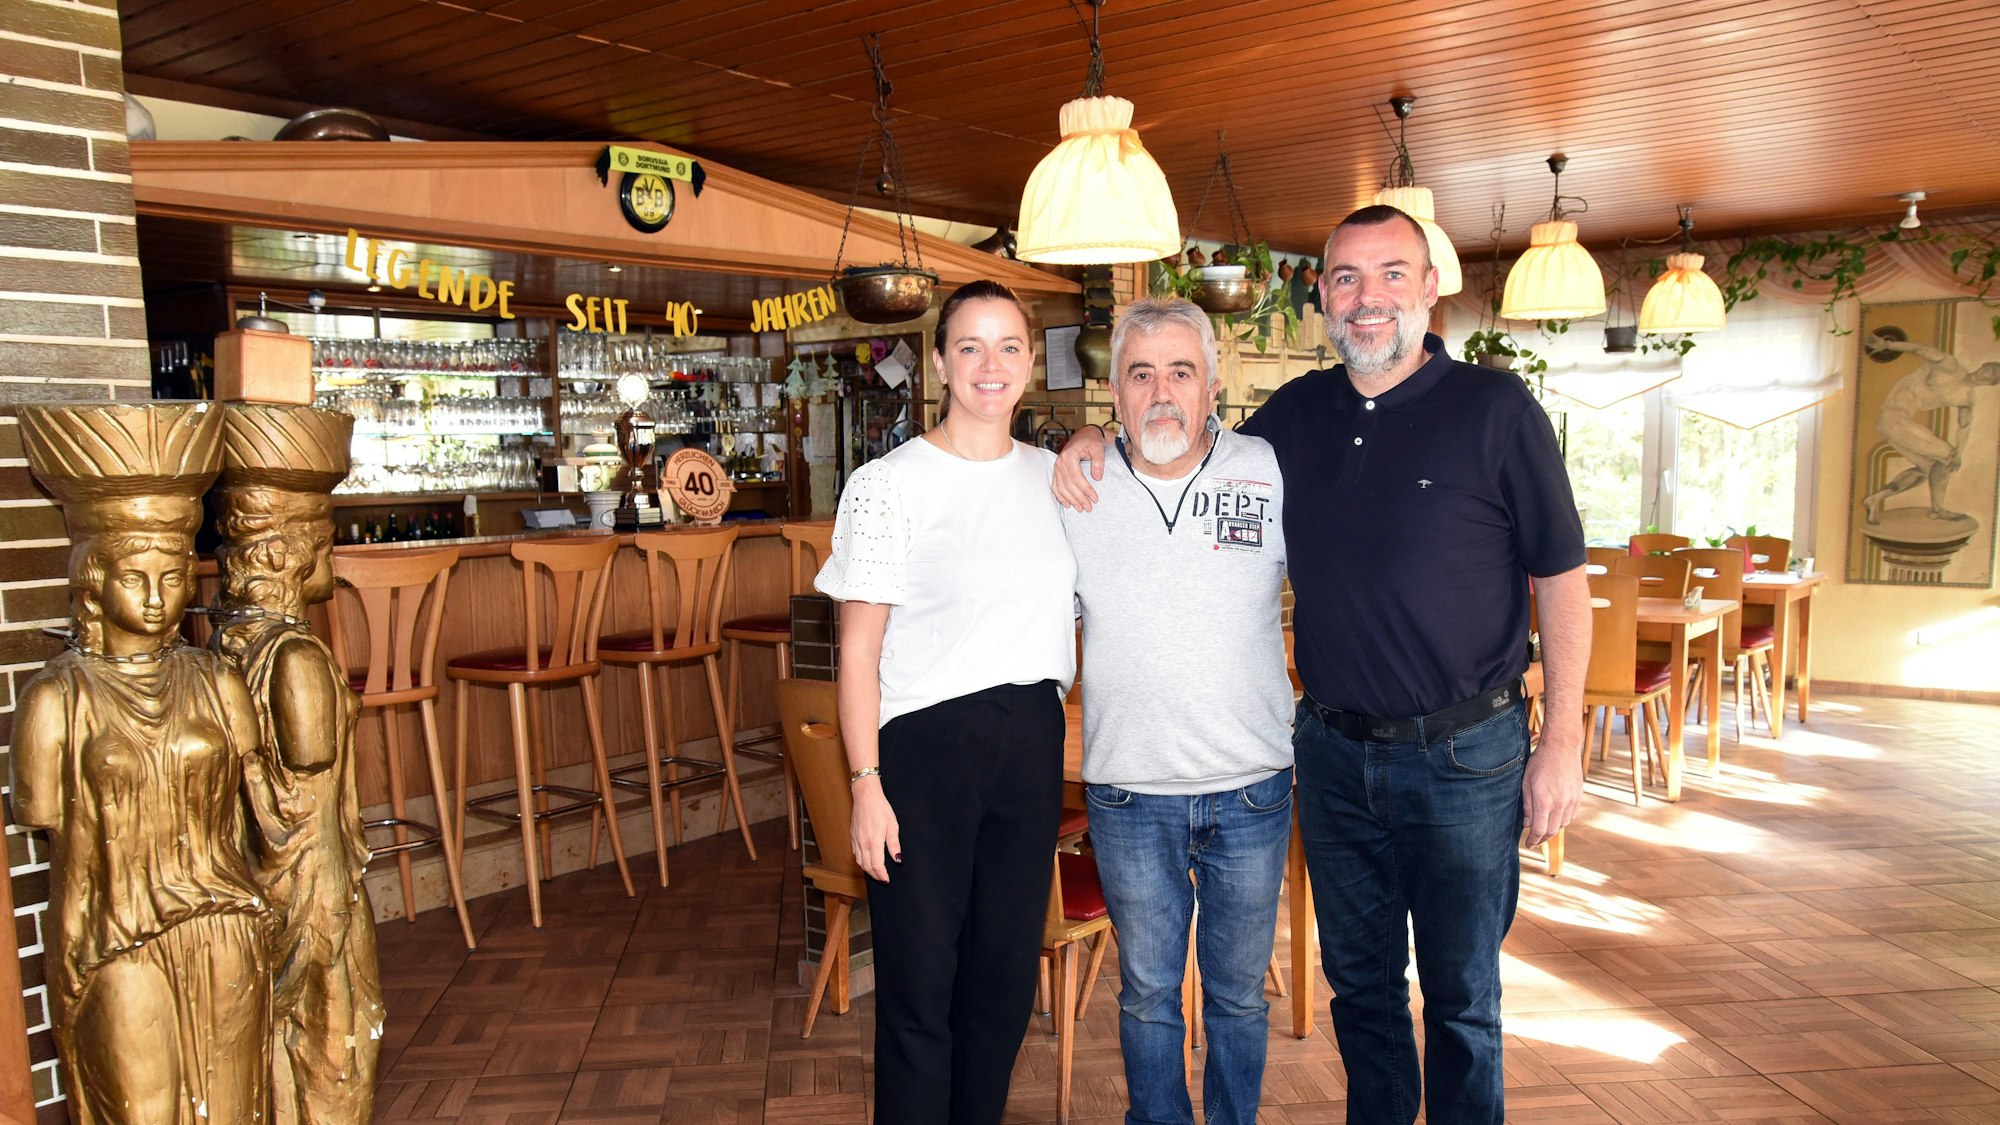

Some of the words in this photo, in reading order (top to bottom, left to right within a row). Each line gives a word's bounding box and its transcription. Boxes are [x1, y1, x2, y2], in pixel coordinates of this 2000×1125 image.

[635, 161, 671, 173] DORTMUND
[637, 155, 668, 165] BORUSSIA
[634, 177, 663, 208] BVB
[345, 228, 516, 319] LEGENDE
[565, 293, 629, 335] SEIT
[665, 301, 698, 337] 40
[750, 282, 837, 333] JAHREN
[673, 451, 716, 467] HERZLICHEN
[685, 472, 714, 496] 40
[678, 497, 726, 517] GLÜCKWUNSCH
[1192, 491, 1273, 523] DEPT.
